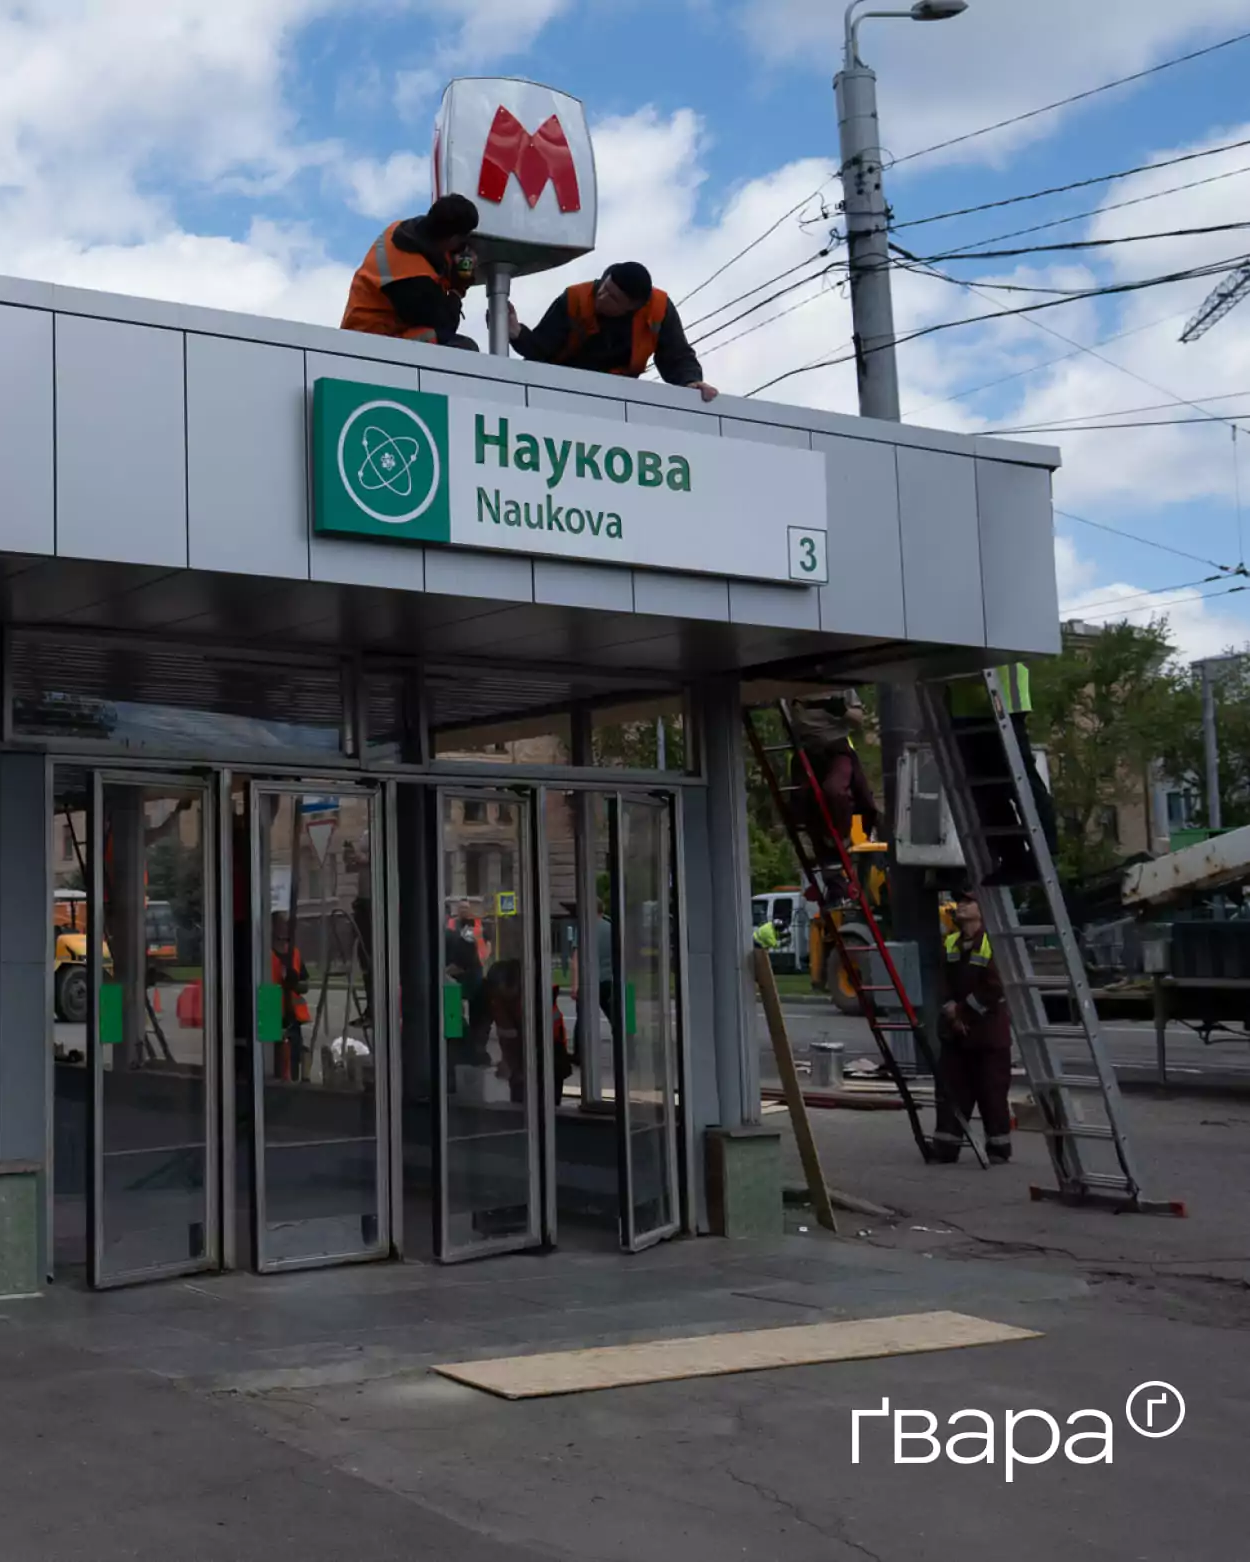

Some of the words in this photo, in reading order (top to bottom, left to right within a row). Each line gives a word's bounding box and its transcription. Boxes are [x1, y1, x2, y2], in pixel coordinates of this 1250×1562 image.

[474, 414, 691, 493] Наукова
[476, 487, 624, 540] Naukova
[799, 536, 818, 573] 3
